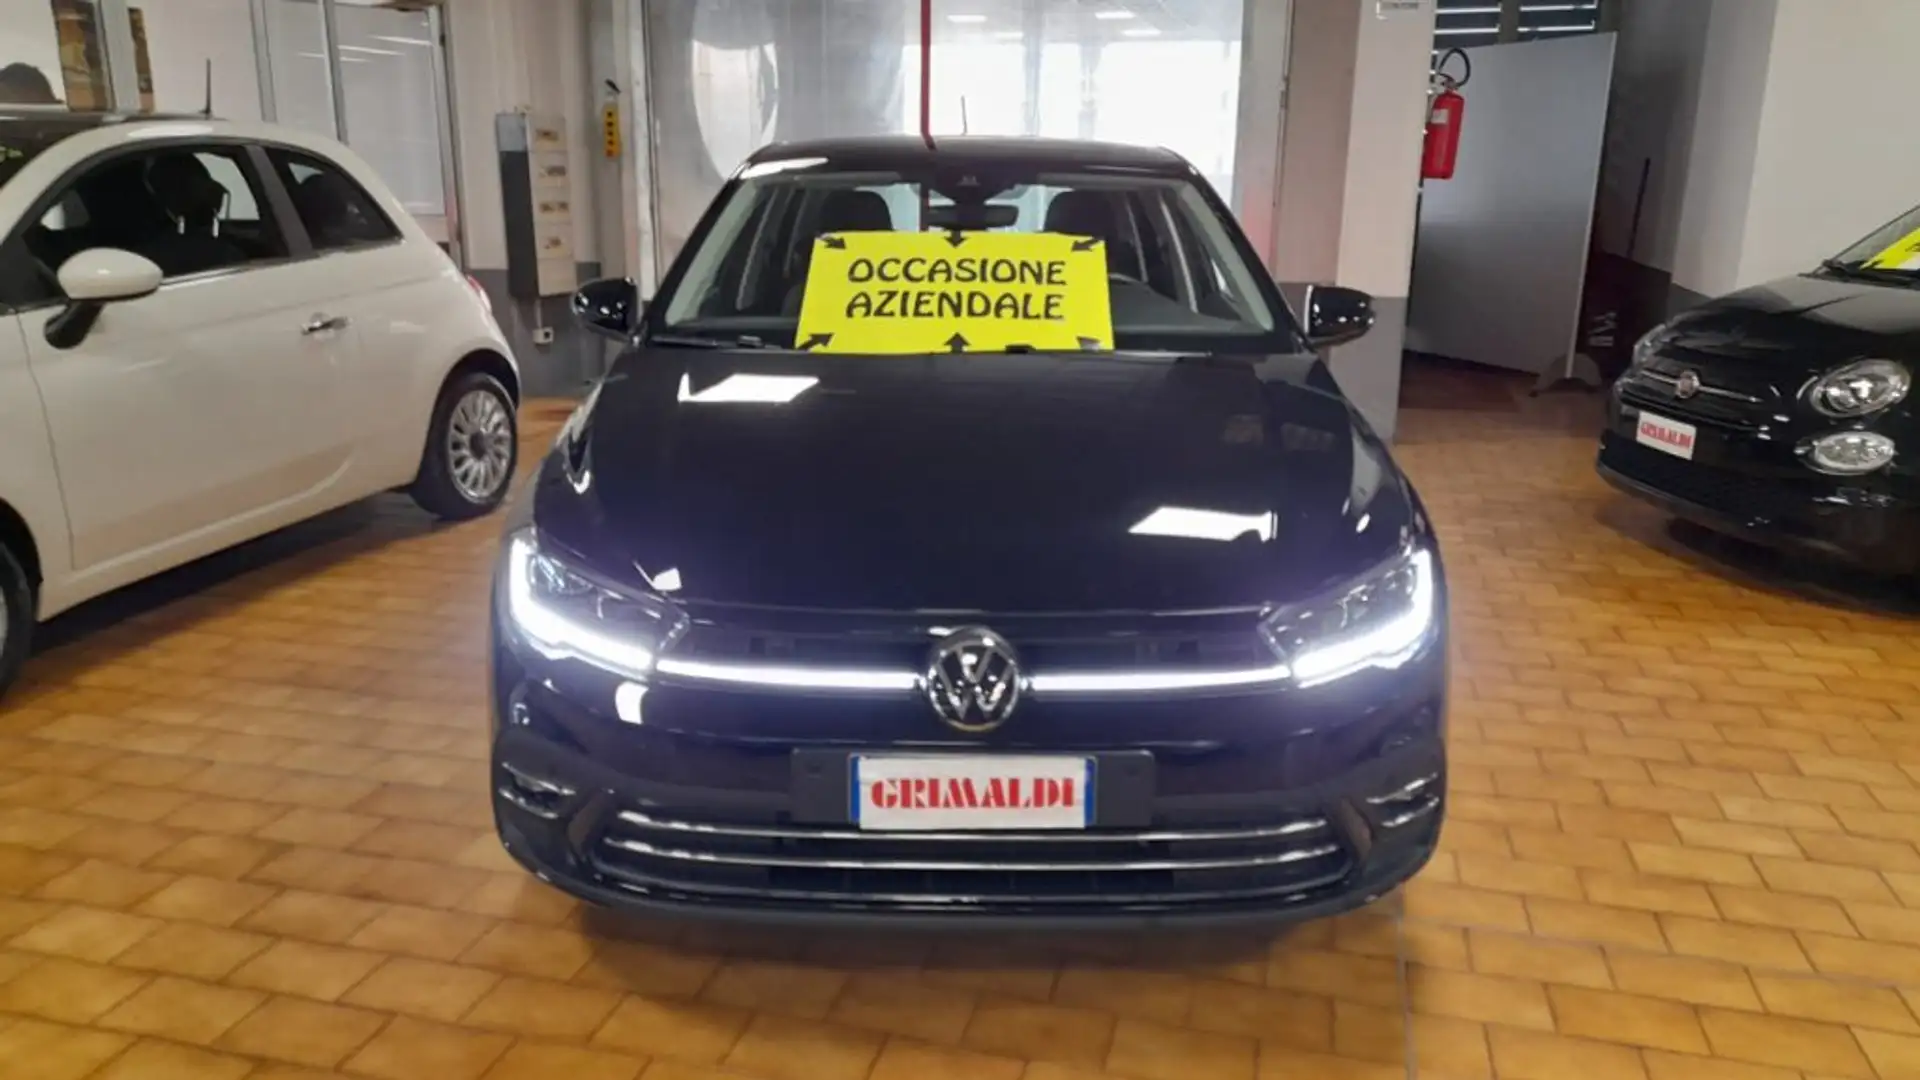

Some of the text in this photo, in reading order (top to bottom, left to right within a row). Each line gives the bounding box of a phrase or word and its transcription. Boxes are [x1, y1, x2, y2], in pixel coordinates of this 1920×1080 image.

[847, 258, 1067, 286] OCCASIONE
[846, 291, 1065, 320] AZIENDALE
[870, 777, 1075, 809] GRIMALDI
